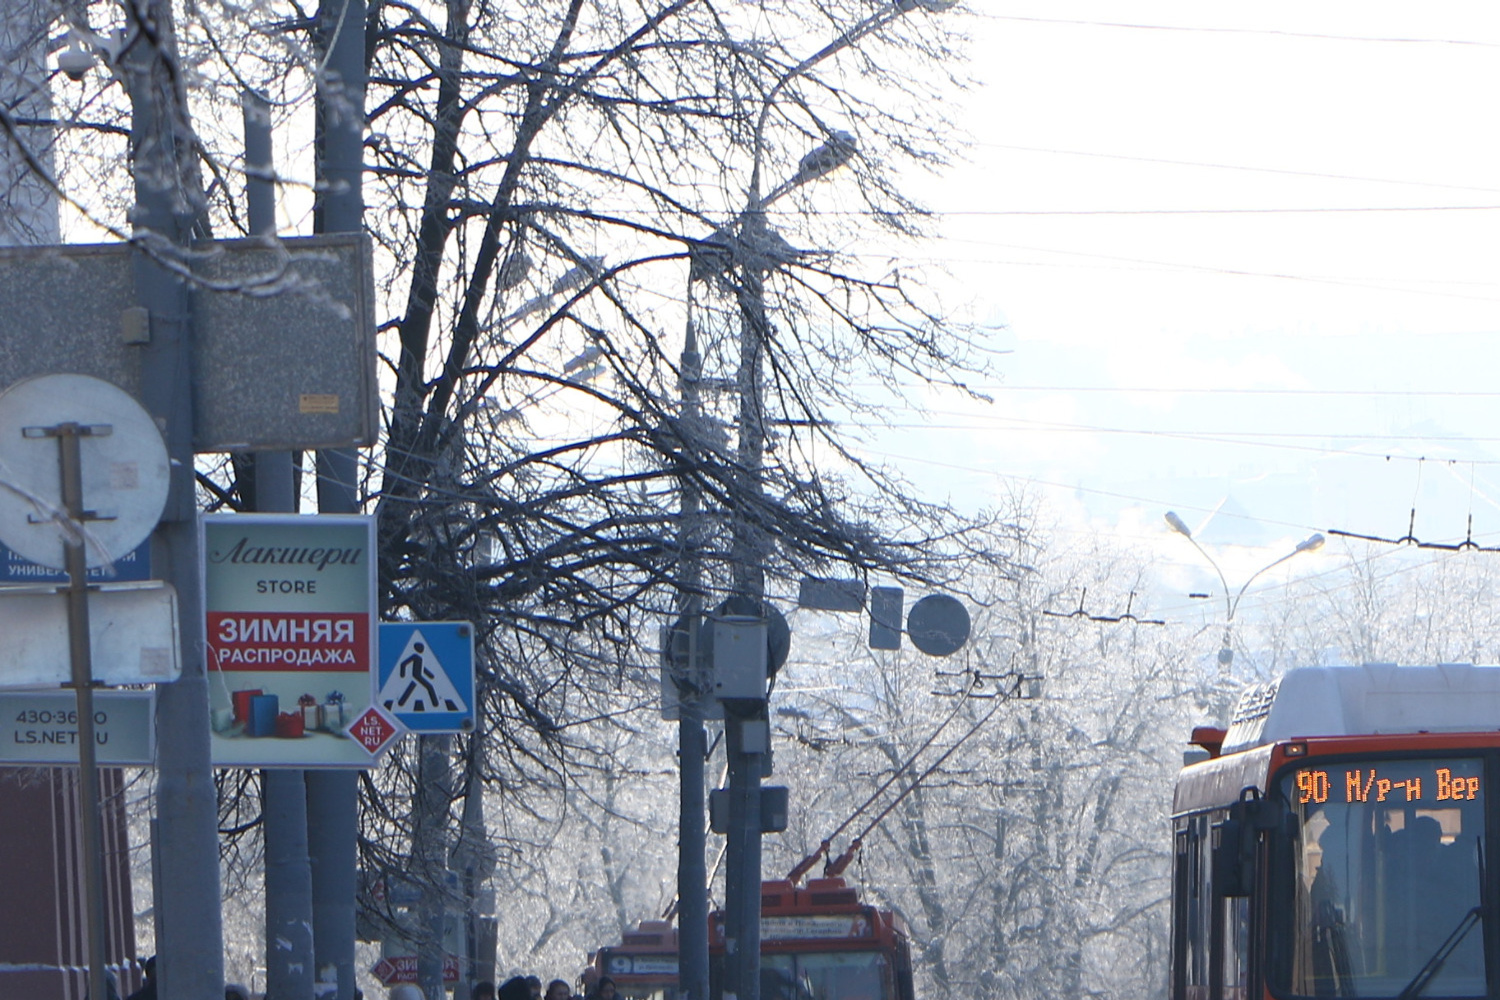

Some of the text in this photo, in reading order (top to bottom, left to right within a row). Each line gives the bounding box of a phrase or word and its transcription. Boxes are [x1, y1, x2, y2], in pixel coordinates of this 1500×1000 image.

[208, 536, 363, 571] Лакшери
[256, 580, 317, 594] STORE
[218, 618, 354, 643] ЗИМНЯЯ
[219, 648, 356, 666] РАСПРОДАЖА
[364, 736, 380, 746] RU
[1296, 770, 1329, 804] 90
[1435, 767, 1479, 801] Вер
